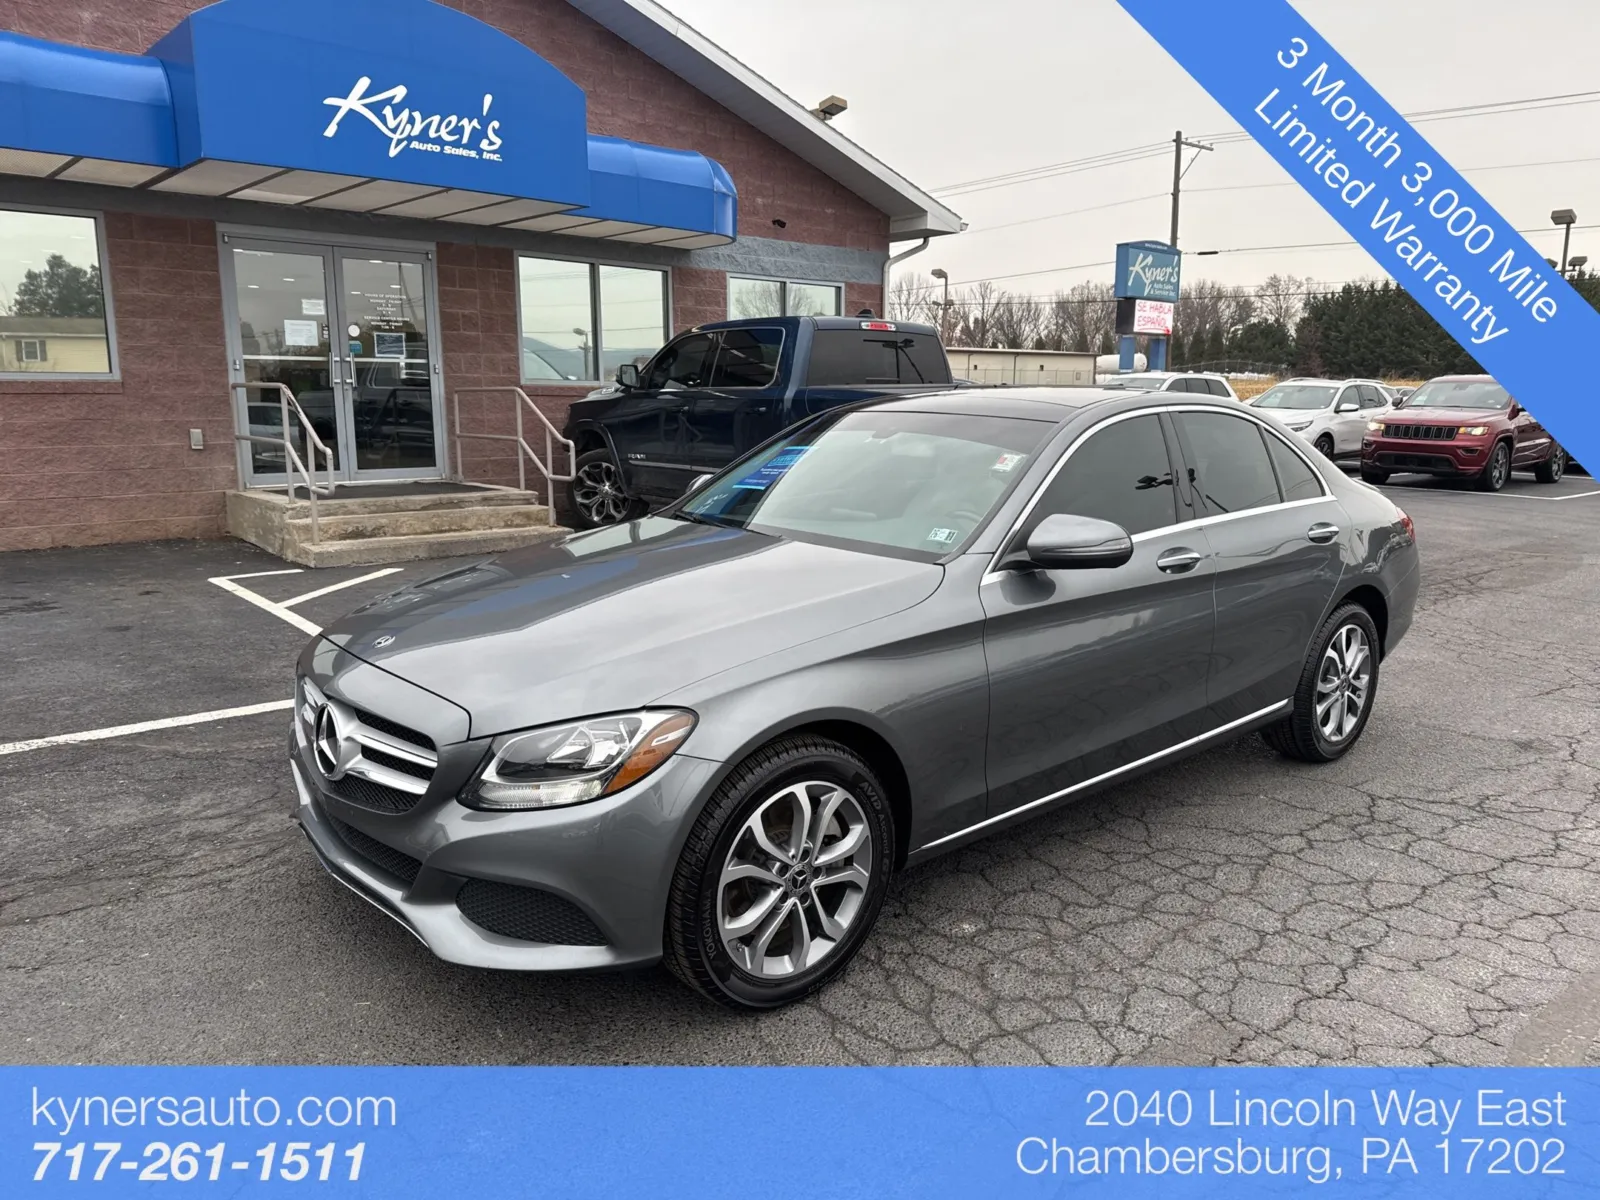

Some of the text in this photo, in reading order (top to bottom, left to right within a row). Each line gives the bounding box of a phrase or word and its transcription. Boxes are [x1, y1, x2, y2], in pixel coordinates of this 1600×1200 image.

[323, 76, 502, 158] Kyner's
[410, 140, 503, 162] Auto Sales, Inc.
[1128, 252, 1178, 296] Kyner's
[1137, 302, 1171, 314] SE HABLA
[1137, 315, 1168, 328] ESPAÑOL
[859, 781, 882, 810] AVID
[702, 888, 717, 960] YOKOHAMA
